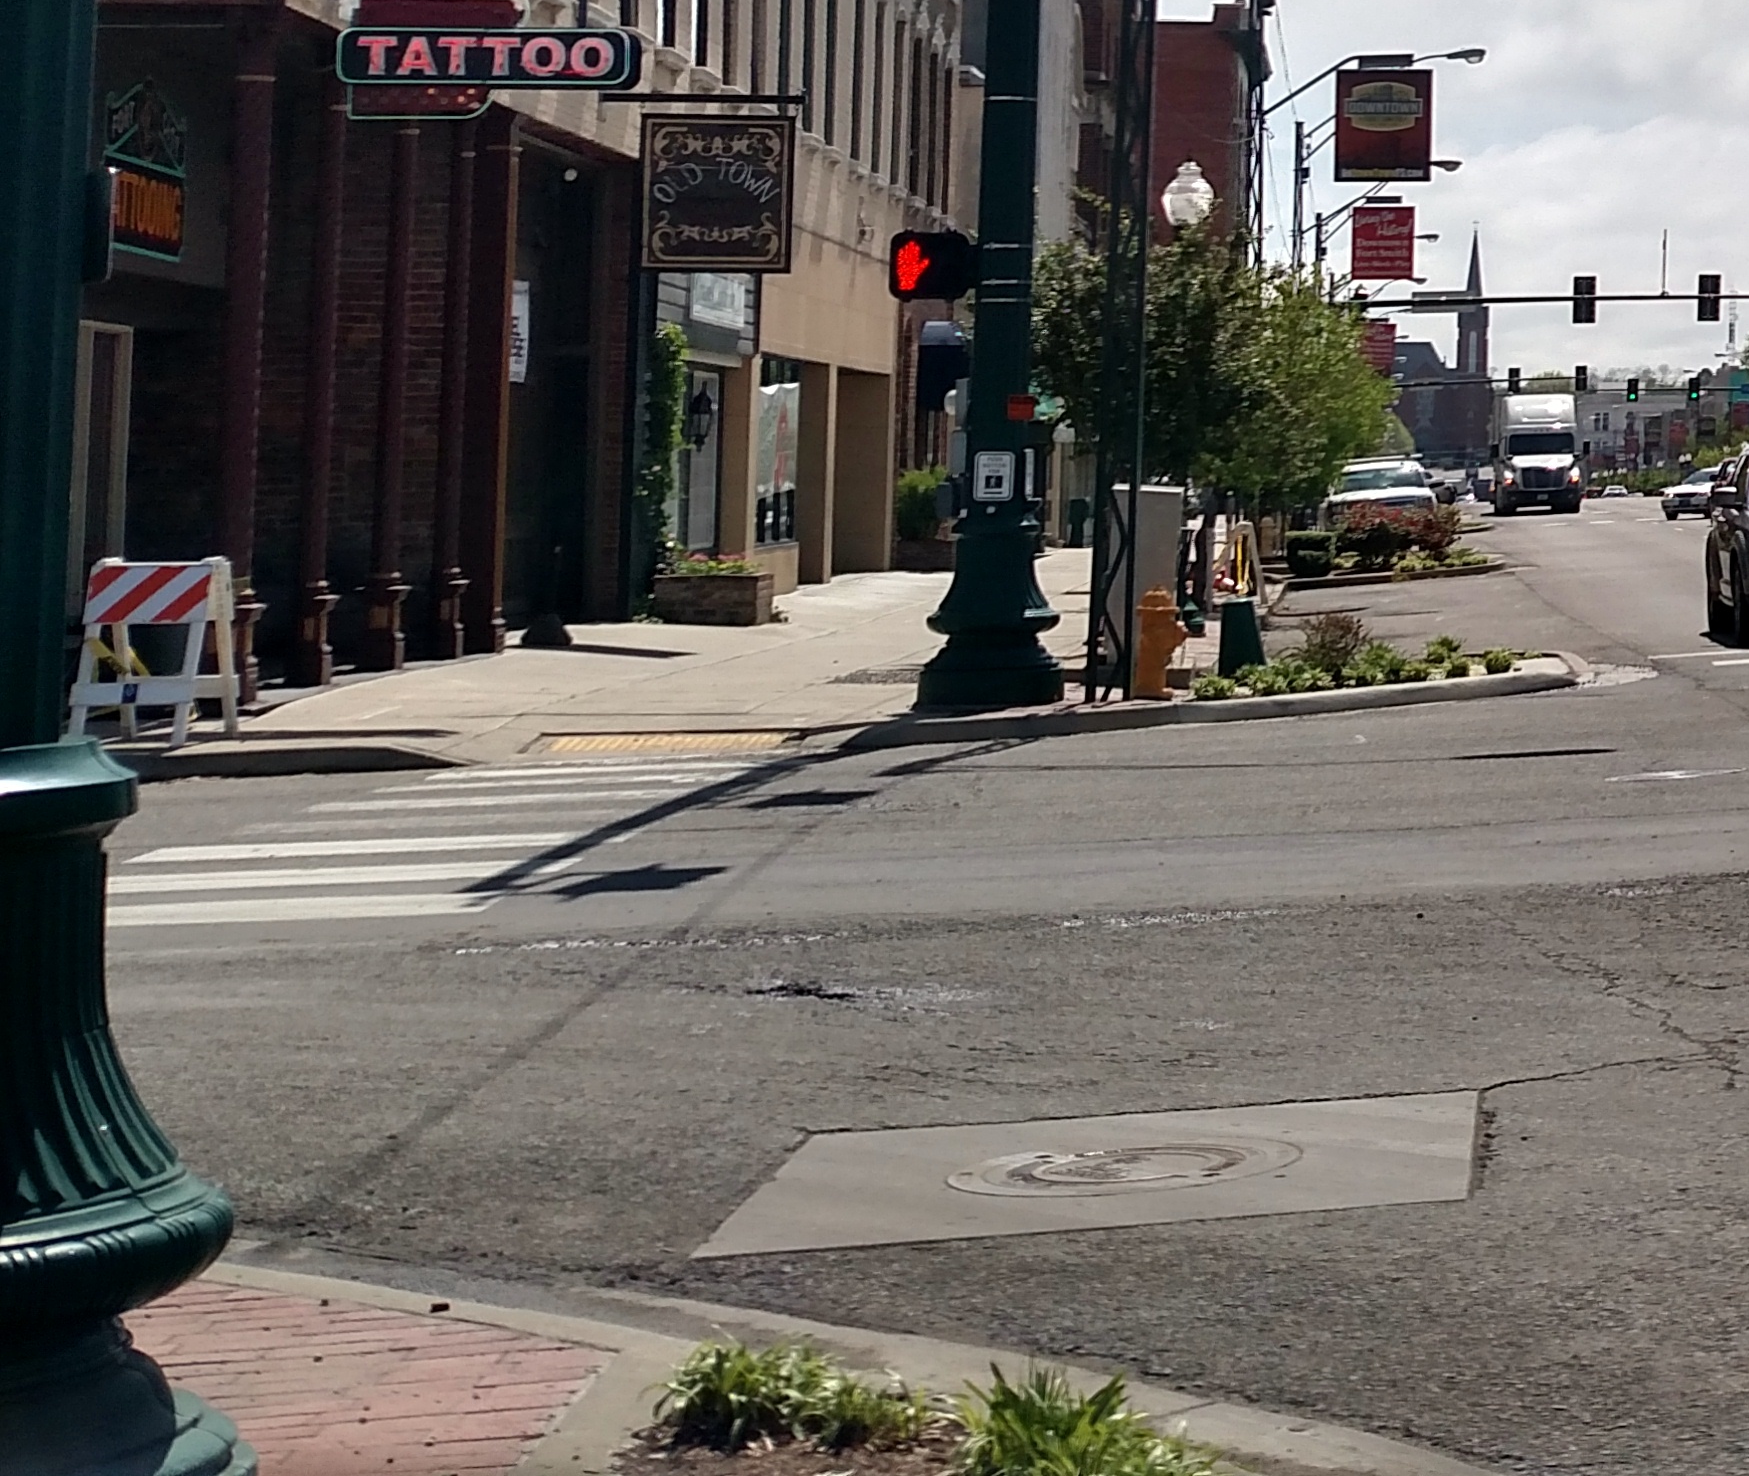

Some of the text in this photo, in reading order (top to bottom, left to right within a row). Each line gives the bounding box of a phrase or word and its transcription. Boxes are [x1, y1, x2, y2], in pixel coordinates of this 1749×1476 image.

[356, 35, 615, 78] TATTOO
[653, 157, 780, 204] OLD TOWN
